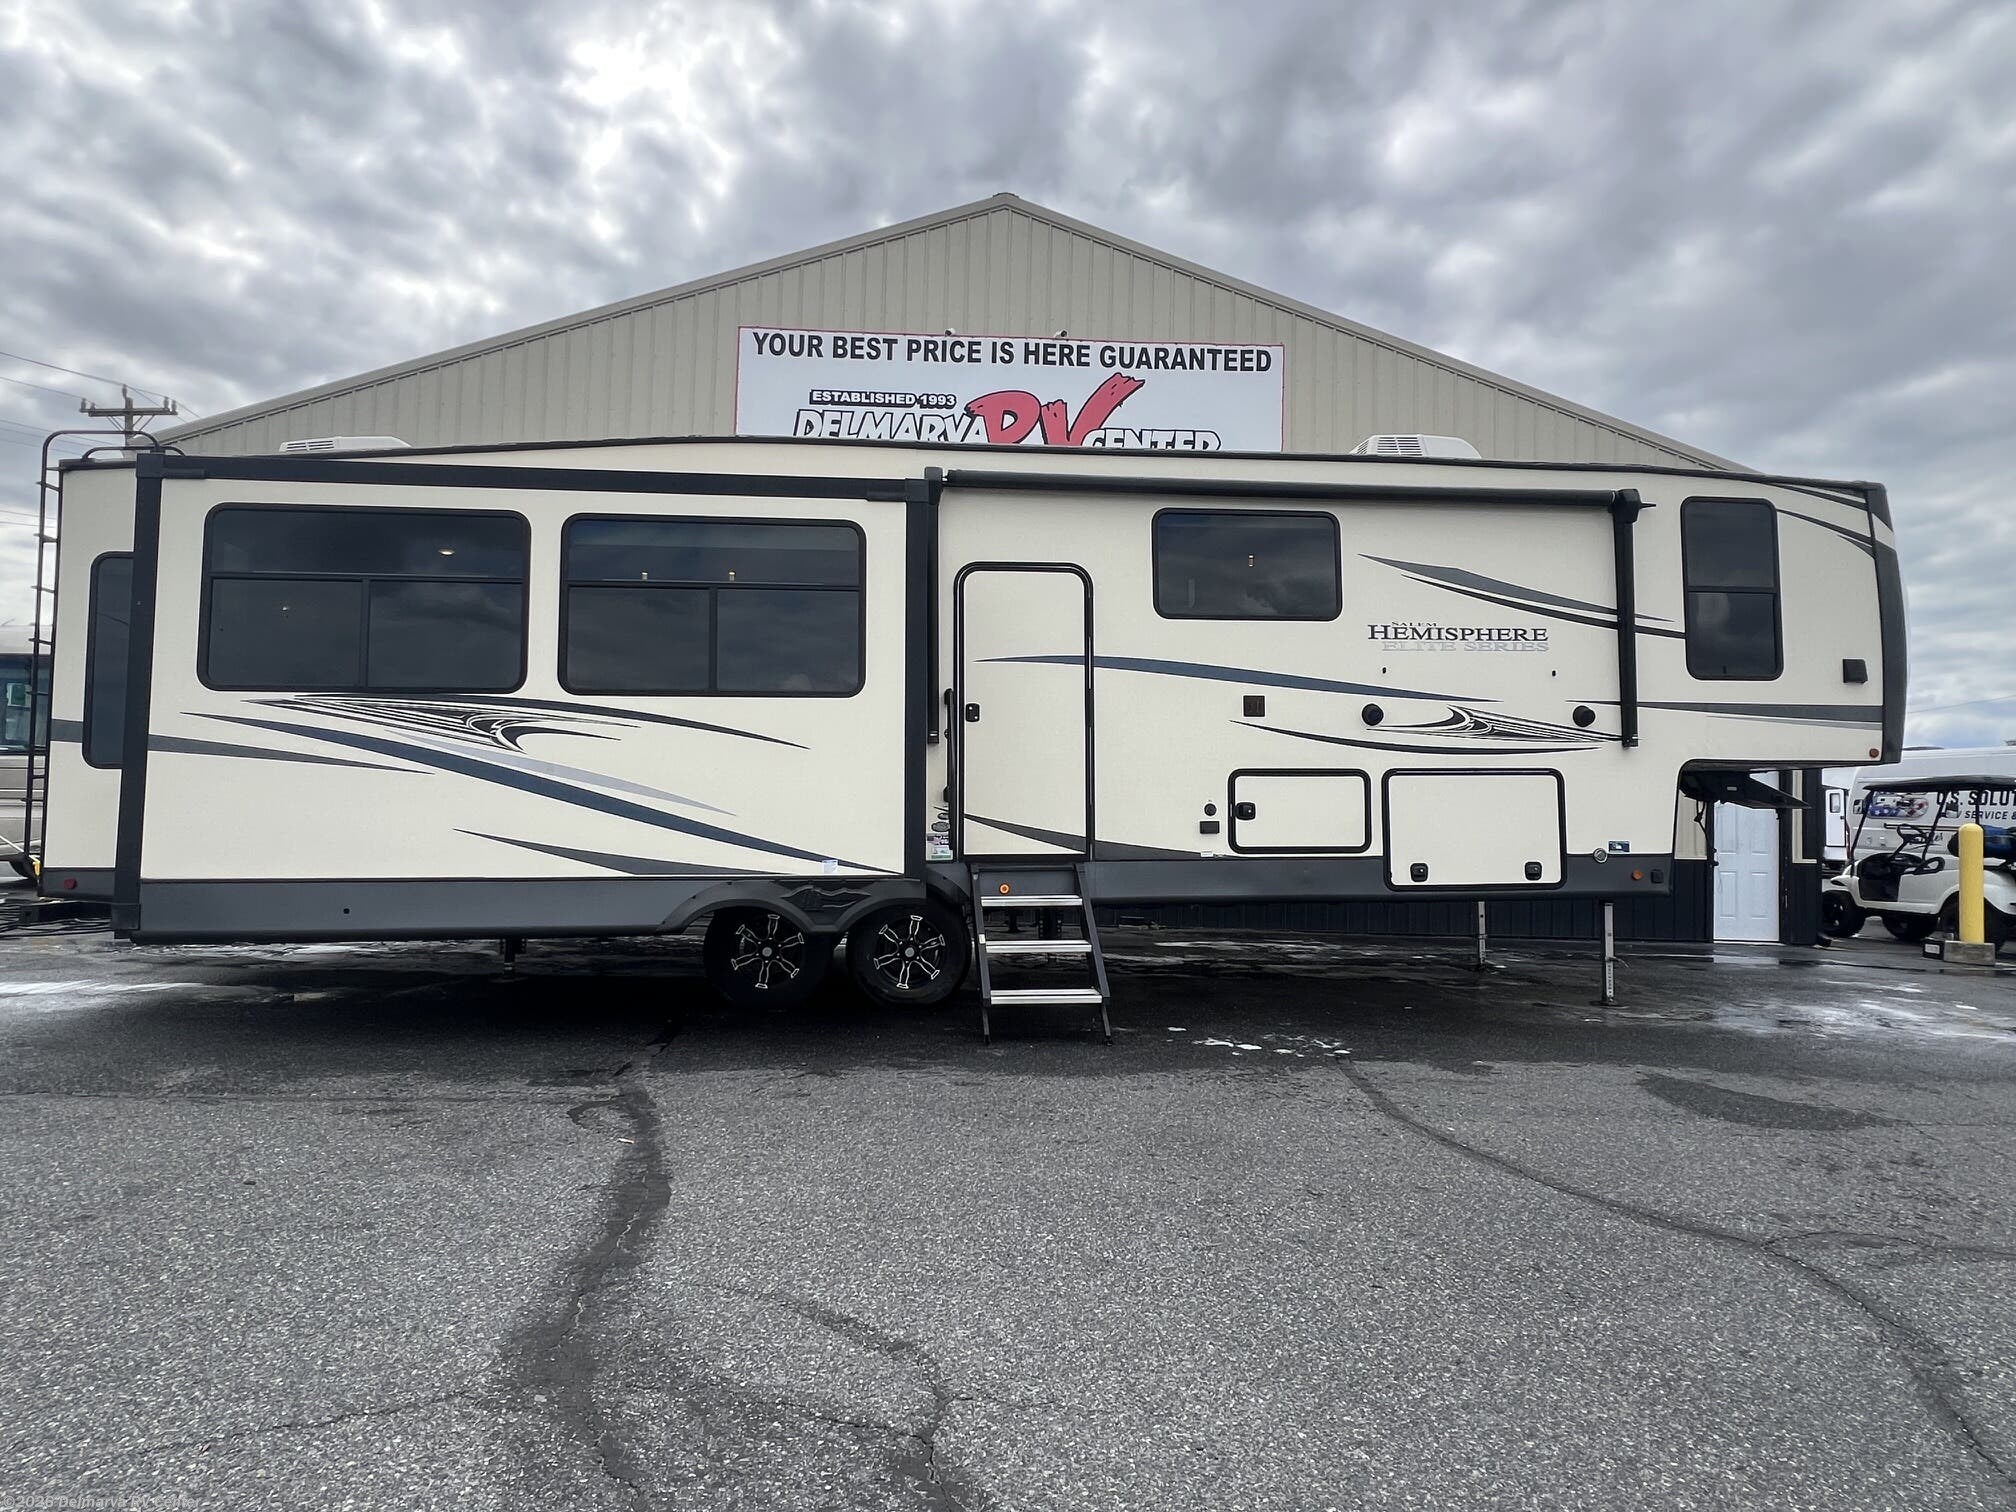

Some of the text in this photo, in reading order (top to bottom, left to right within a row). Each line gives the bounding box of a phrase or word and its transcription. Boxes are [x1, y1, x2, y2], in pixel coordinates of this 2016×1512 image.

[752, 332, 1272, 372] YOUR BEST PRICE IS HERE GUARANTEED
[812, 390, 956, 408] ESTABLISHED 1993
[794, 409, 990, 443] DELMARVA
[964, 371, 1146, 446] RV
[1367, 624, 1549, 642] HEMISPHERE
[1382, 641, 1549, 652] ELITE SERIES
[1964, 810, 2009, 820] SERVICE
